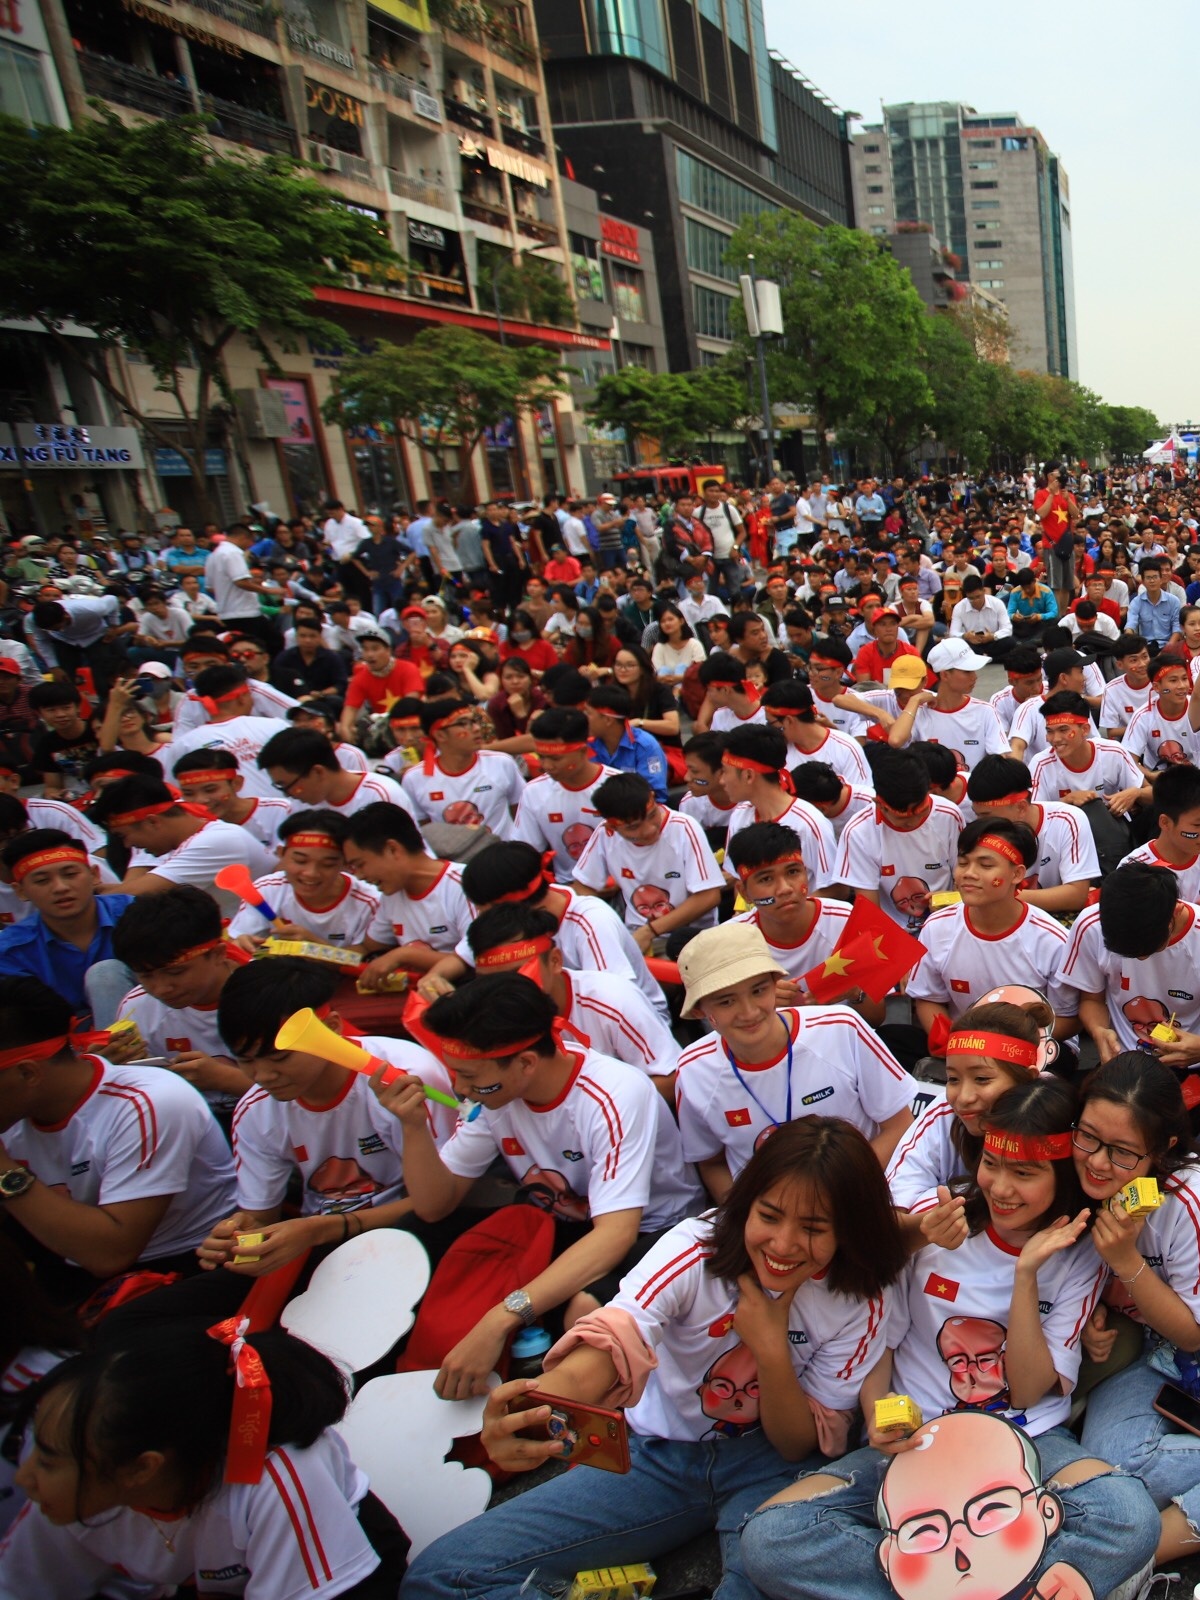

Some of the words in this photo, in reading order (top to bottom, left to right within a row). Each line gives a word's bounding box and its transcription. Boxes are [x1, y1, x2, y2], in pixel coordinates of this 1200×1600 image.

[51, 447, 79, 462] FU
[83, 447, 131, 462] TANG
[983, 836, 1000, 849] CHIẾN
[1001, 845, 1017, 861] THẮNG
[487, 951, 512, 965] CHIẾN
[513, 945, 536, 960] THẮNG
[1169, 990, 1192, 1000] VPMILK
[957, 1035, 986, 1050] THẮNG
[1001, 1041, 1024, 1059] Tiger
[803, 1086, 832, 1104] VPMILK
[990, 1134, 1019, 1153] THẮNG
[239, 1410, 260, 1446] Tiger
